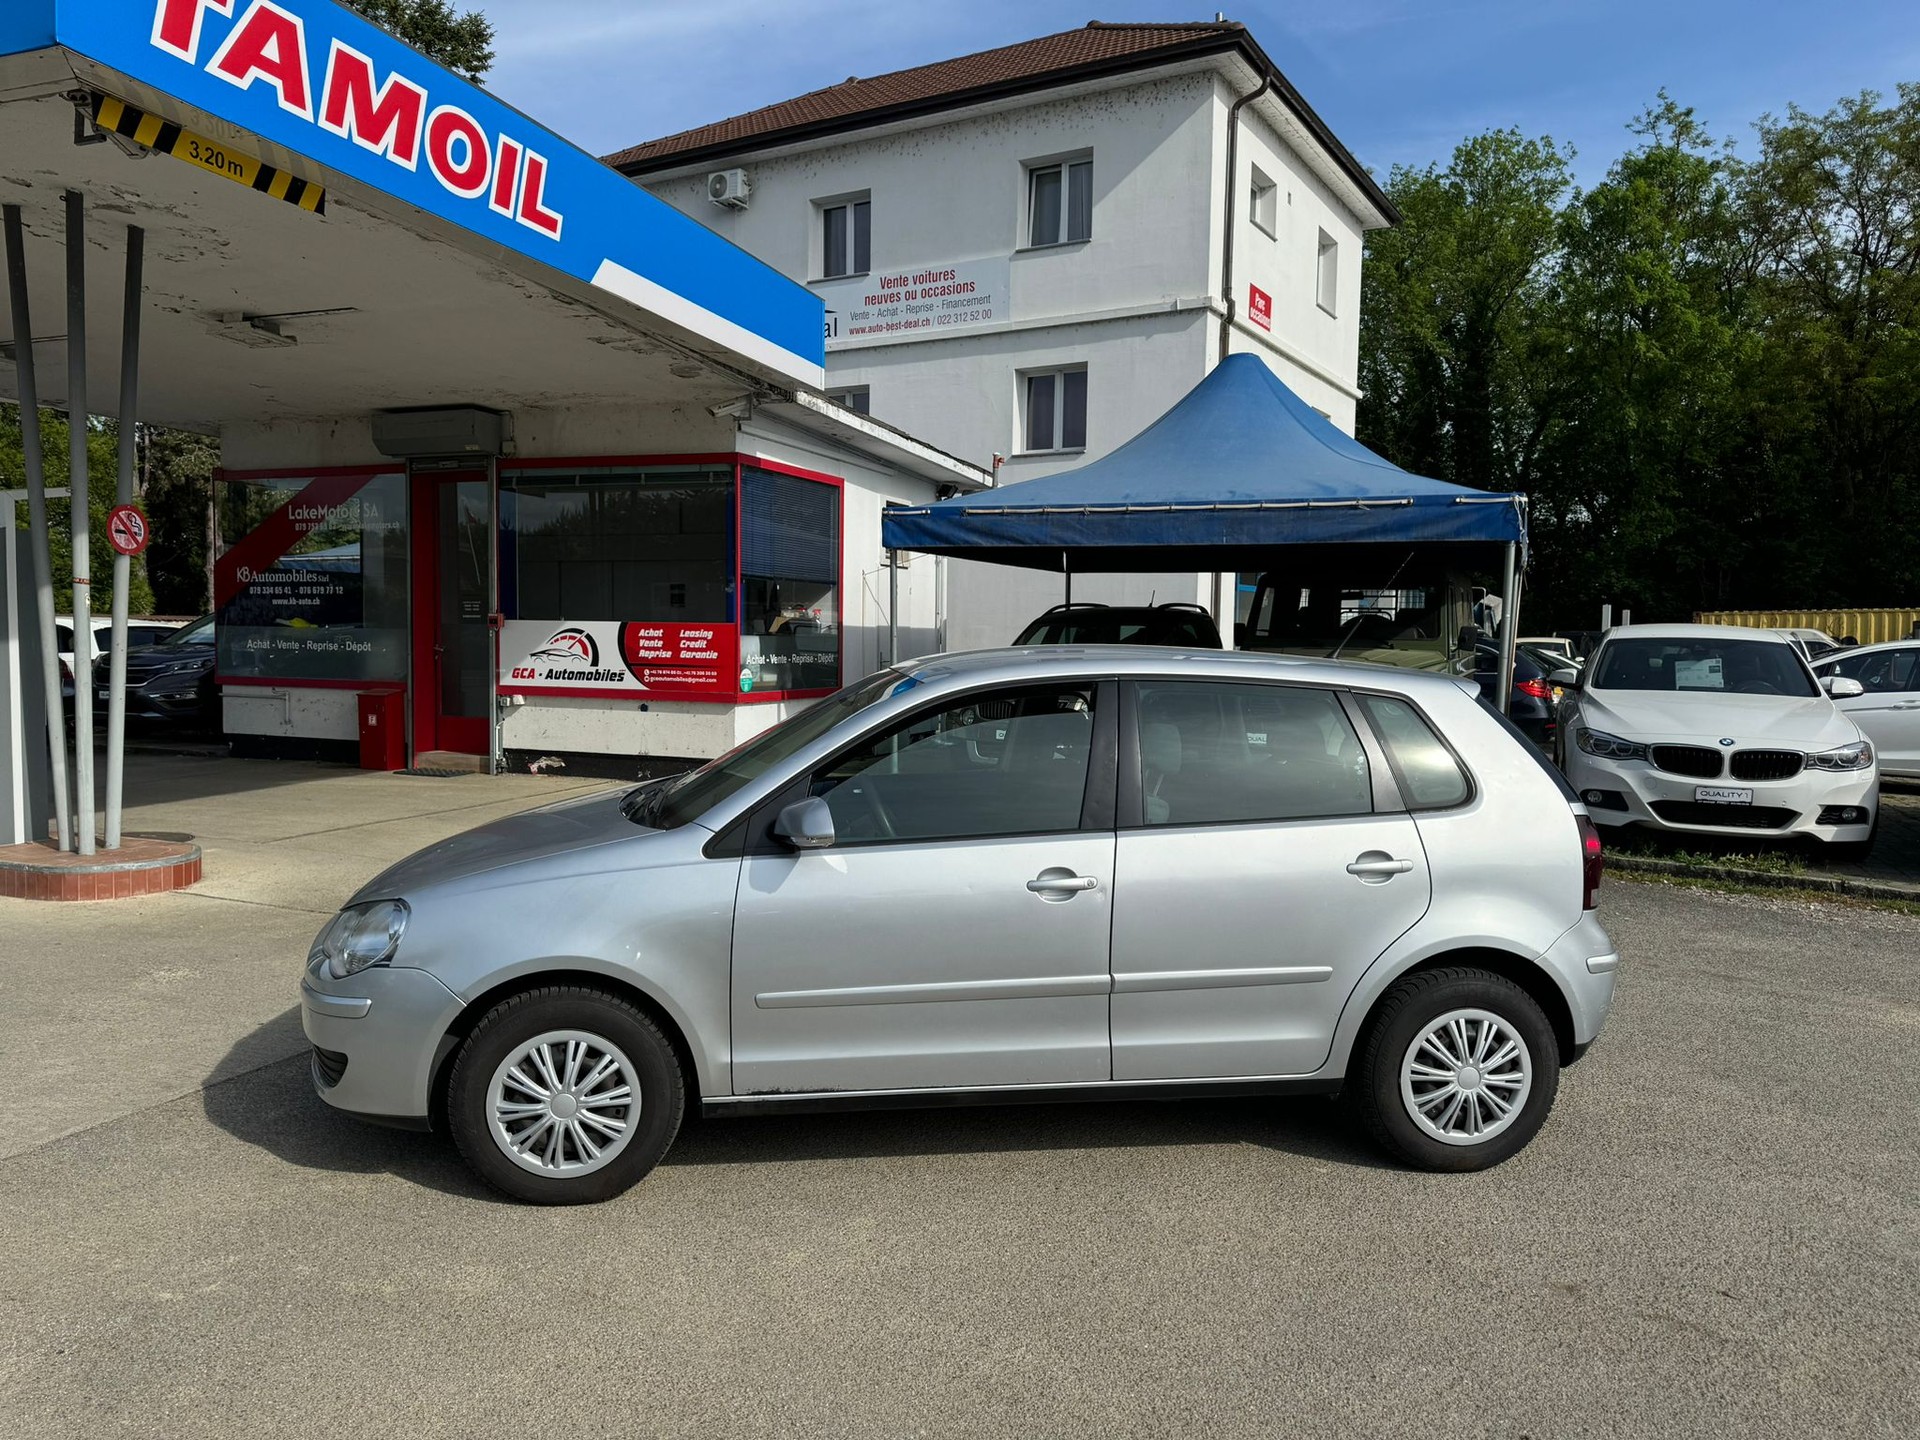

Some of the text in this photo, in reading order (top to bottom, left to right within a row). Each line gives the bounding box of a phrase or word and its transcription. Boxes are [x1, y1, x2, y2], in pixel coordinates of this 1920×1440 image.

[151, 0, 563, 241] TAMOIL
[189, 140, 243, 178] 3.20 m
[880, 269, 956, 290] Vente voitures
[864, 281, 976, 306] neuves ou occasions
[850, 310, 870, 321] Vente
[877, 306, 899, 319] Achat
[905, 301, 934, 316] Reprise
[941, 294, 991, 310] Financement
[848, 317, 931, 335] www.auto-best-deal.ch
[937, 313, 952, 326] 022
[953, 311, 968, 324] 312
[970, 309, 980, 321] 52
[982, 308, 992, 320] 00
[363, 502, 378, 518] SA
[638, 629, 664, 637] Achat
[680, 629, 713, 640] Leasing
[247, 639, 270, 650] Achat
[276, 640, 299, 651] Vente
[306, 640, 339, 653] Reprise
[345, 641, 371, 653] Dépôt
[639, 639, 663, 647] Vente
[638, 650, 672, 659] Reprise
[680, 650, 718, 659] Garantie
[746, 654, 766, 665] Achat
[770, 654, 787, 664] Vente
[792, 653, 814, 666] Reprise
[512, 668, 536, 680] GCA
[544, 668, 626, 682] Automobiles
[1700, 790, 1743, 798] QUALITY
